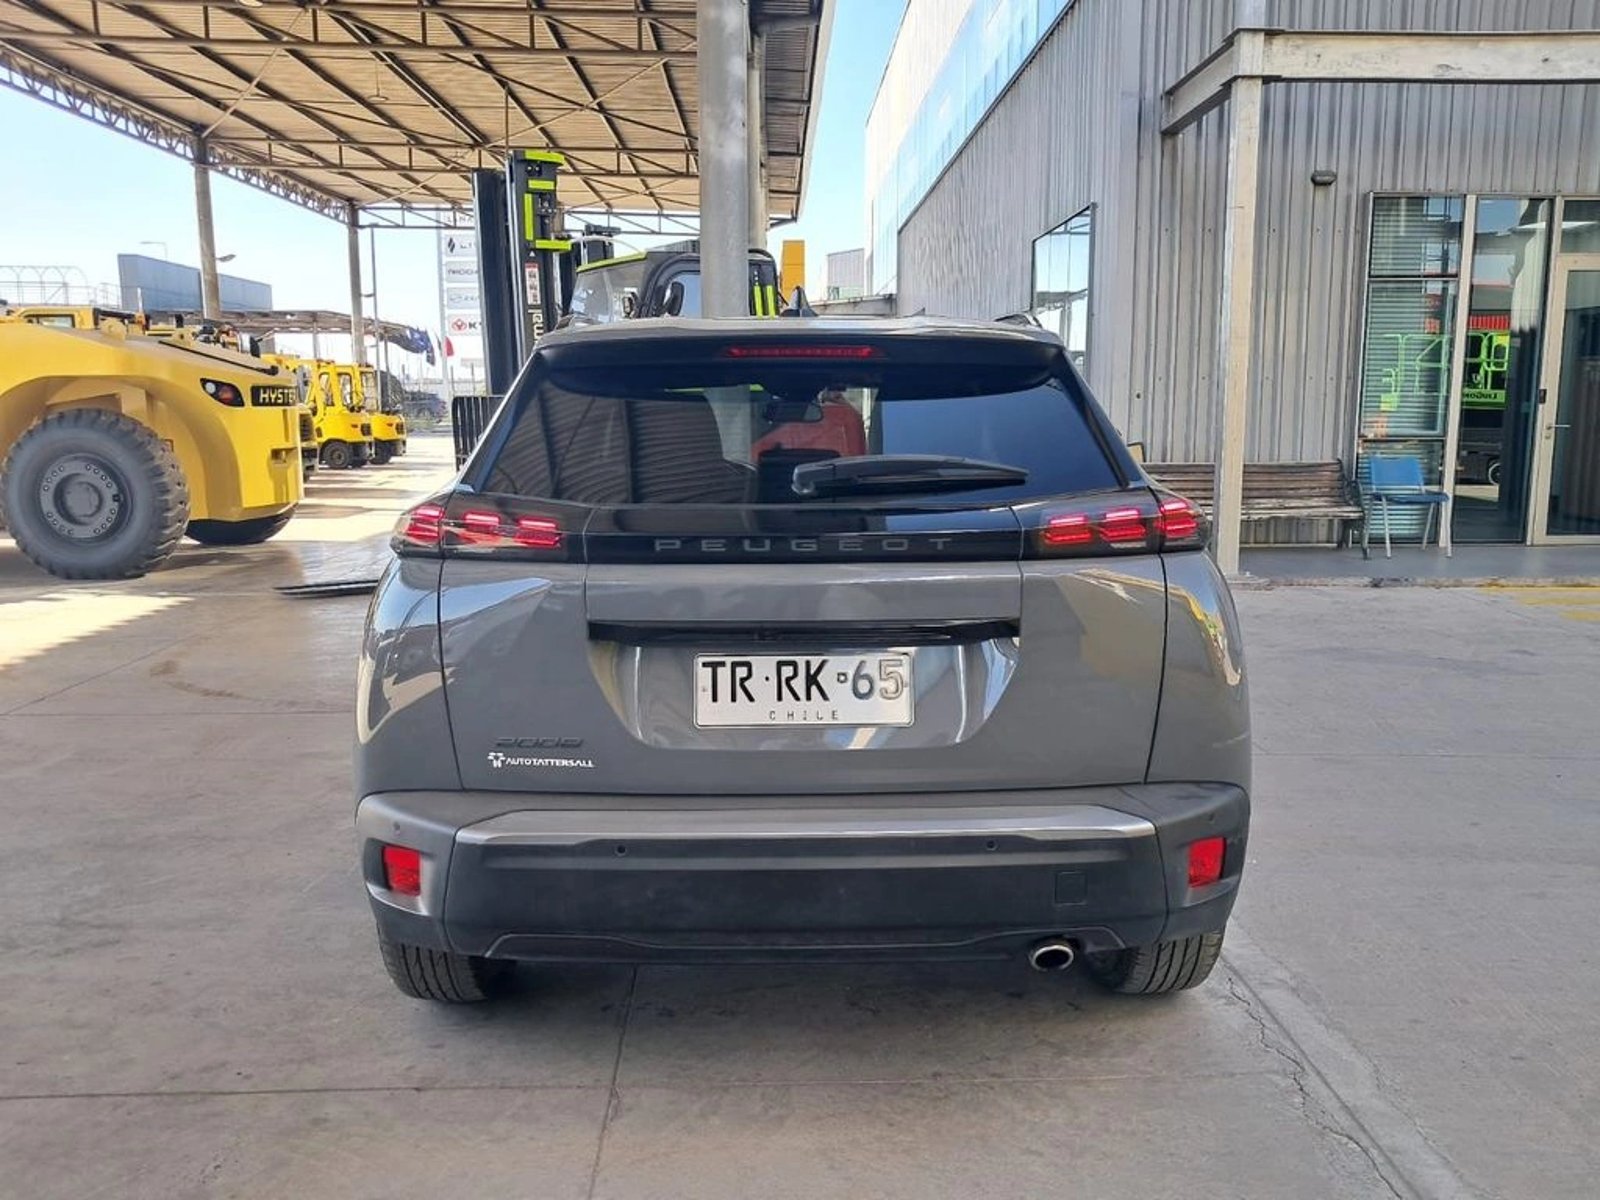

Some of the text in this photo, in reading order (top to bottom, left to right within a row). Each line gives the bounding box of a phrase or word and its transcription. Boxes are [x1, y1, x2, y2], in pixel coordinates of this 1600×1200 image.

[653, 538, 953, 552] PEUGEOT
[769, 710, 840, 721] CHILE
[495, 736, 584, 748] 2008
